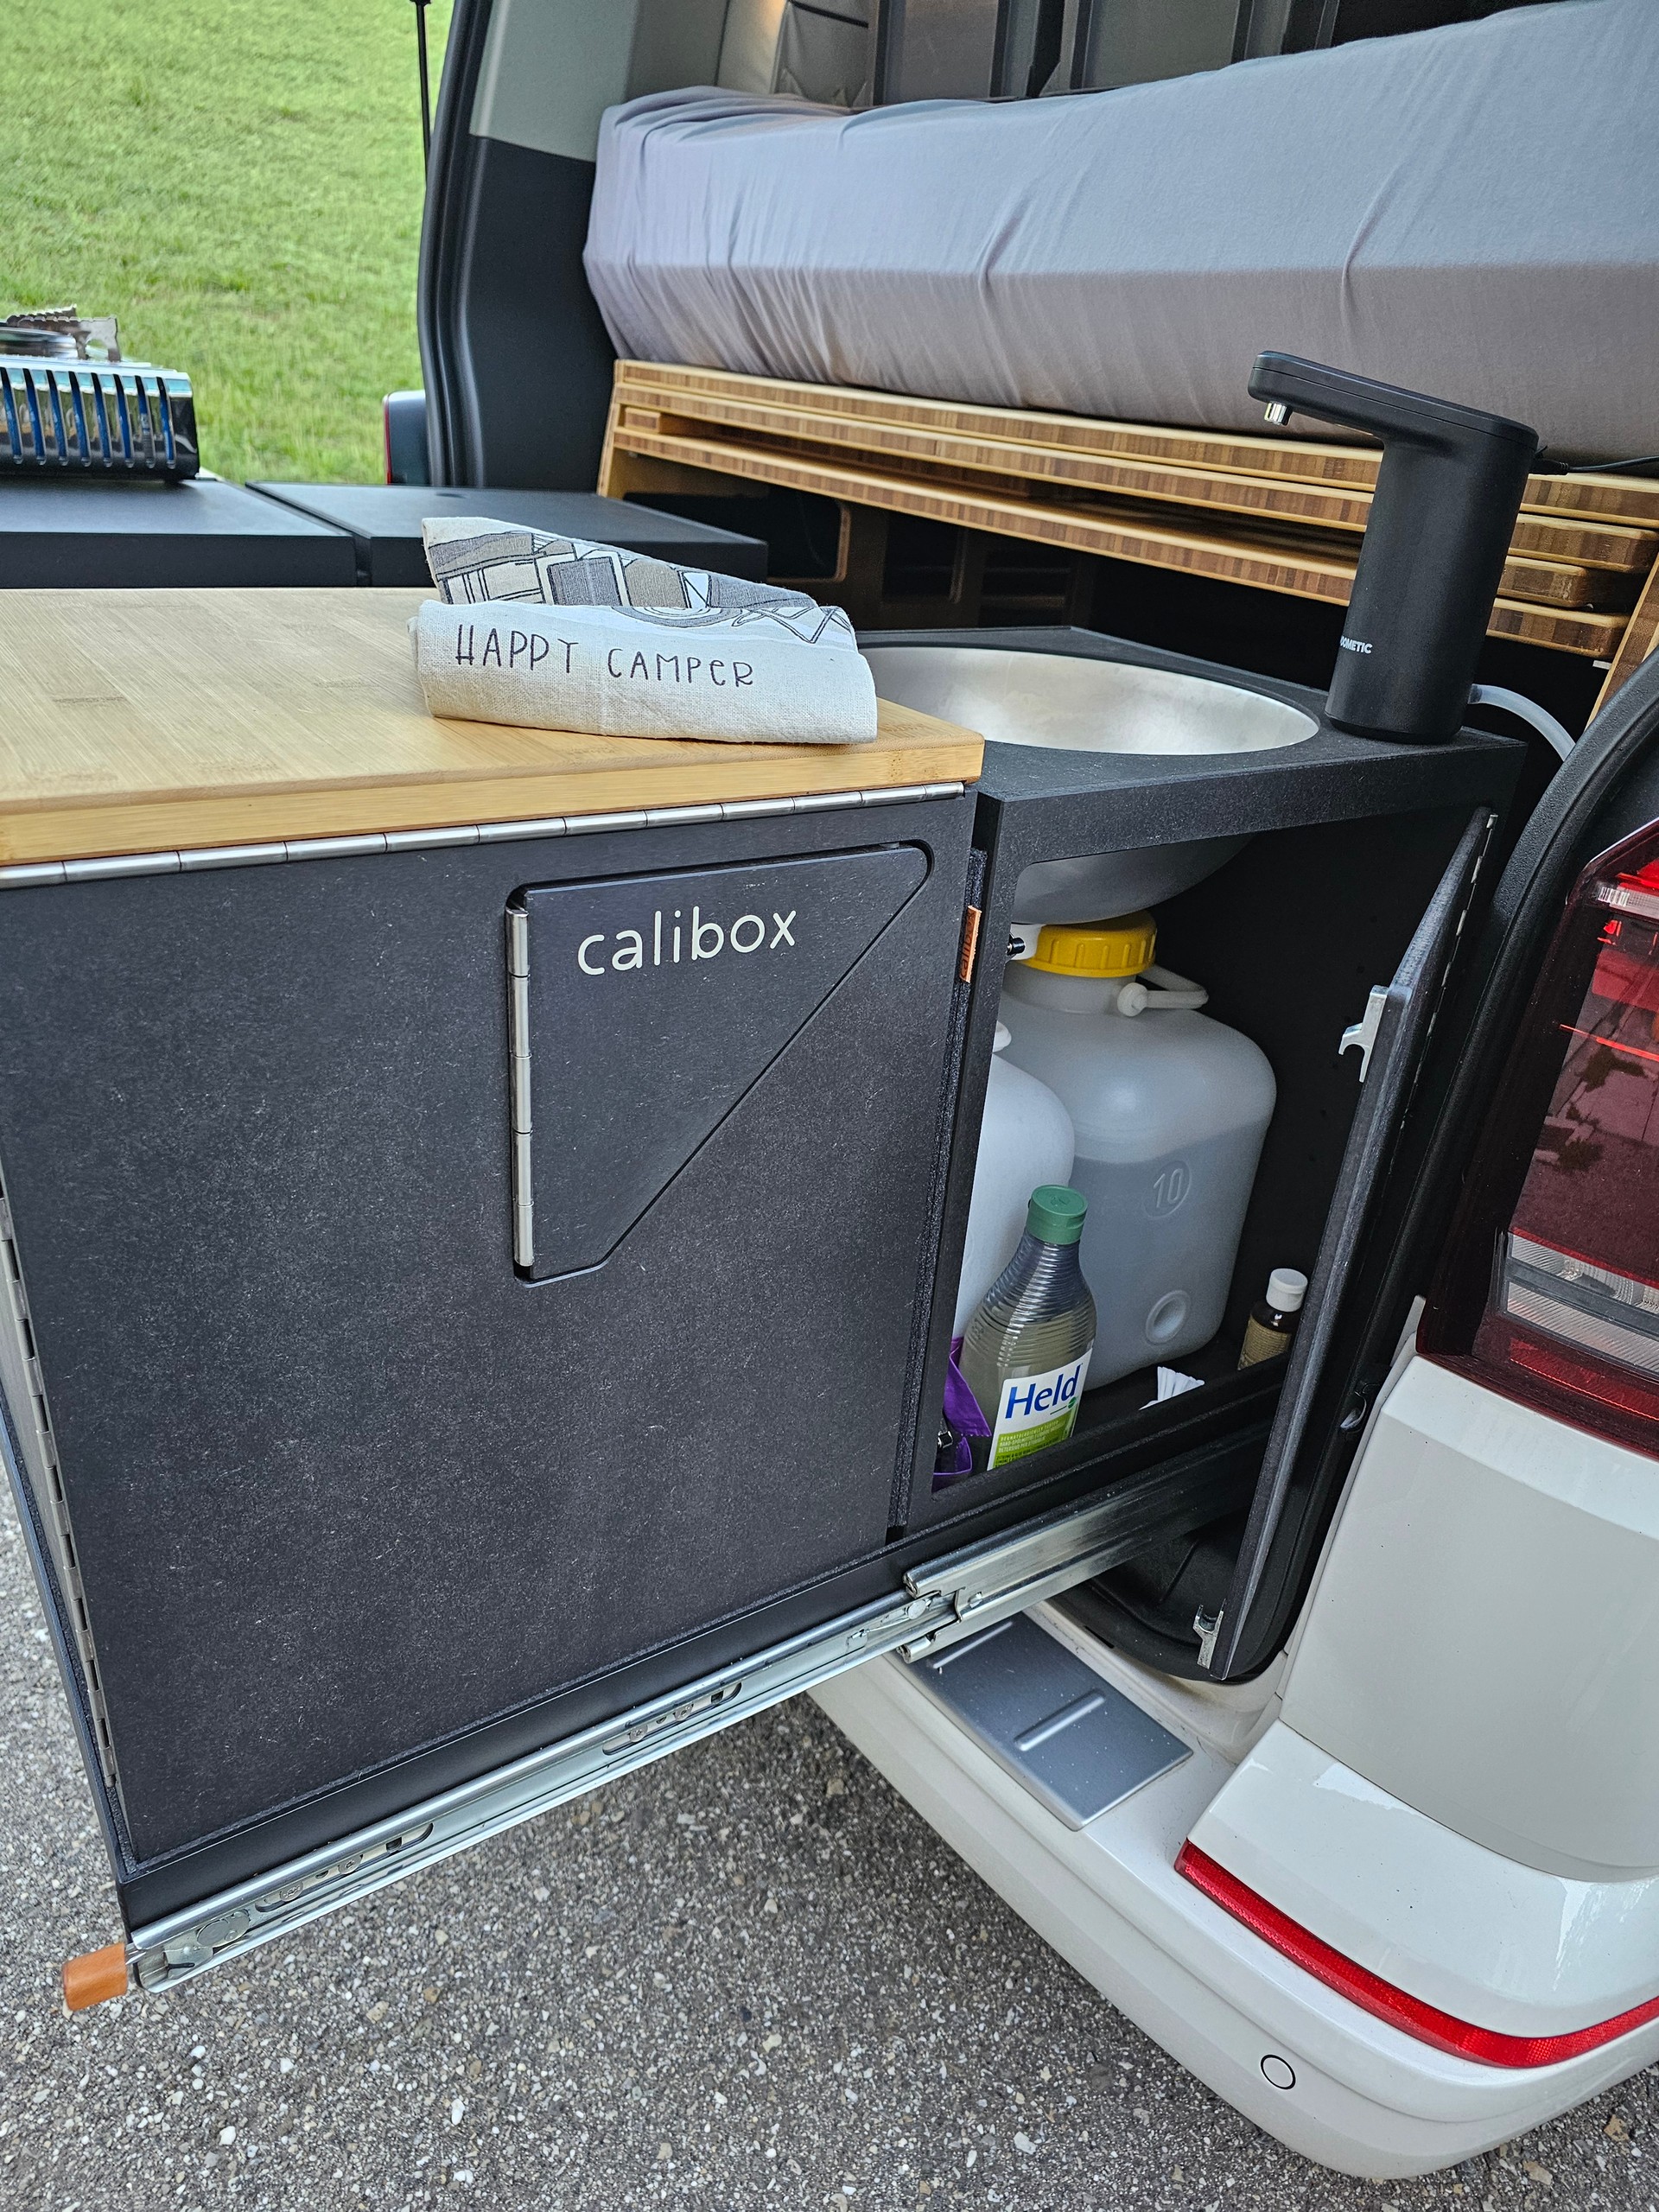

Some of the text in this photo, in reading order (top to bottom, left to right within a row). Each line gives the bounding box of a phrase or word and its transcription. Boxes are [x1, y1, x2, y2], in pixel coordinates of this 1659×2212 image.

[455, 624, 753, 688] HAPPY CAMPER
[578, 906, 797, 976] calibox
[1153, 1168, 1184, 1208] 10
[1005, 1364, 1081, 1419] Held
